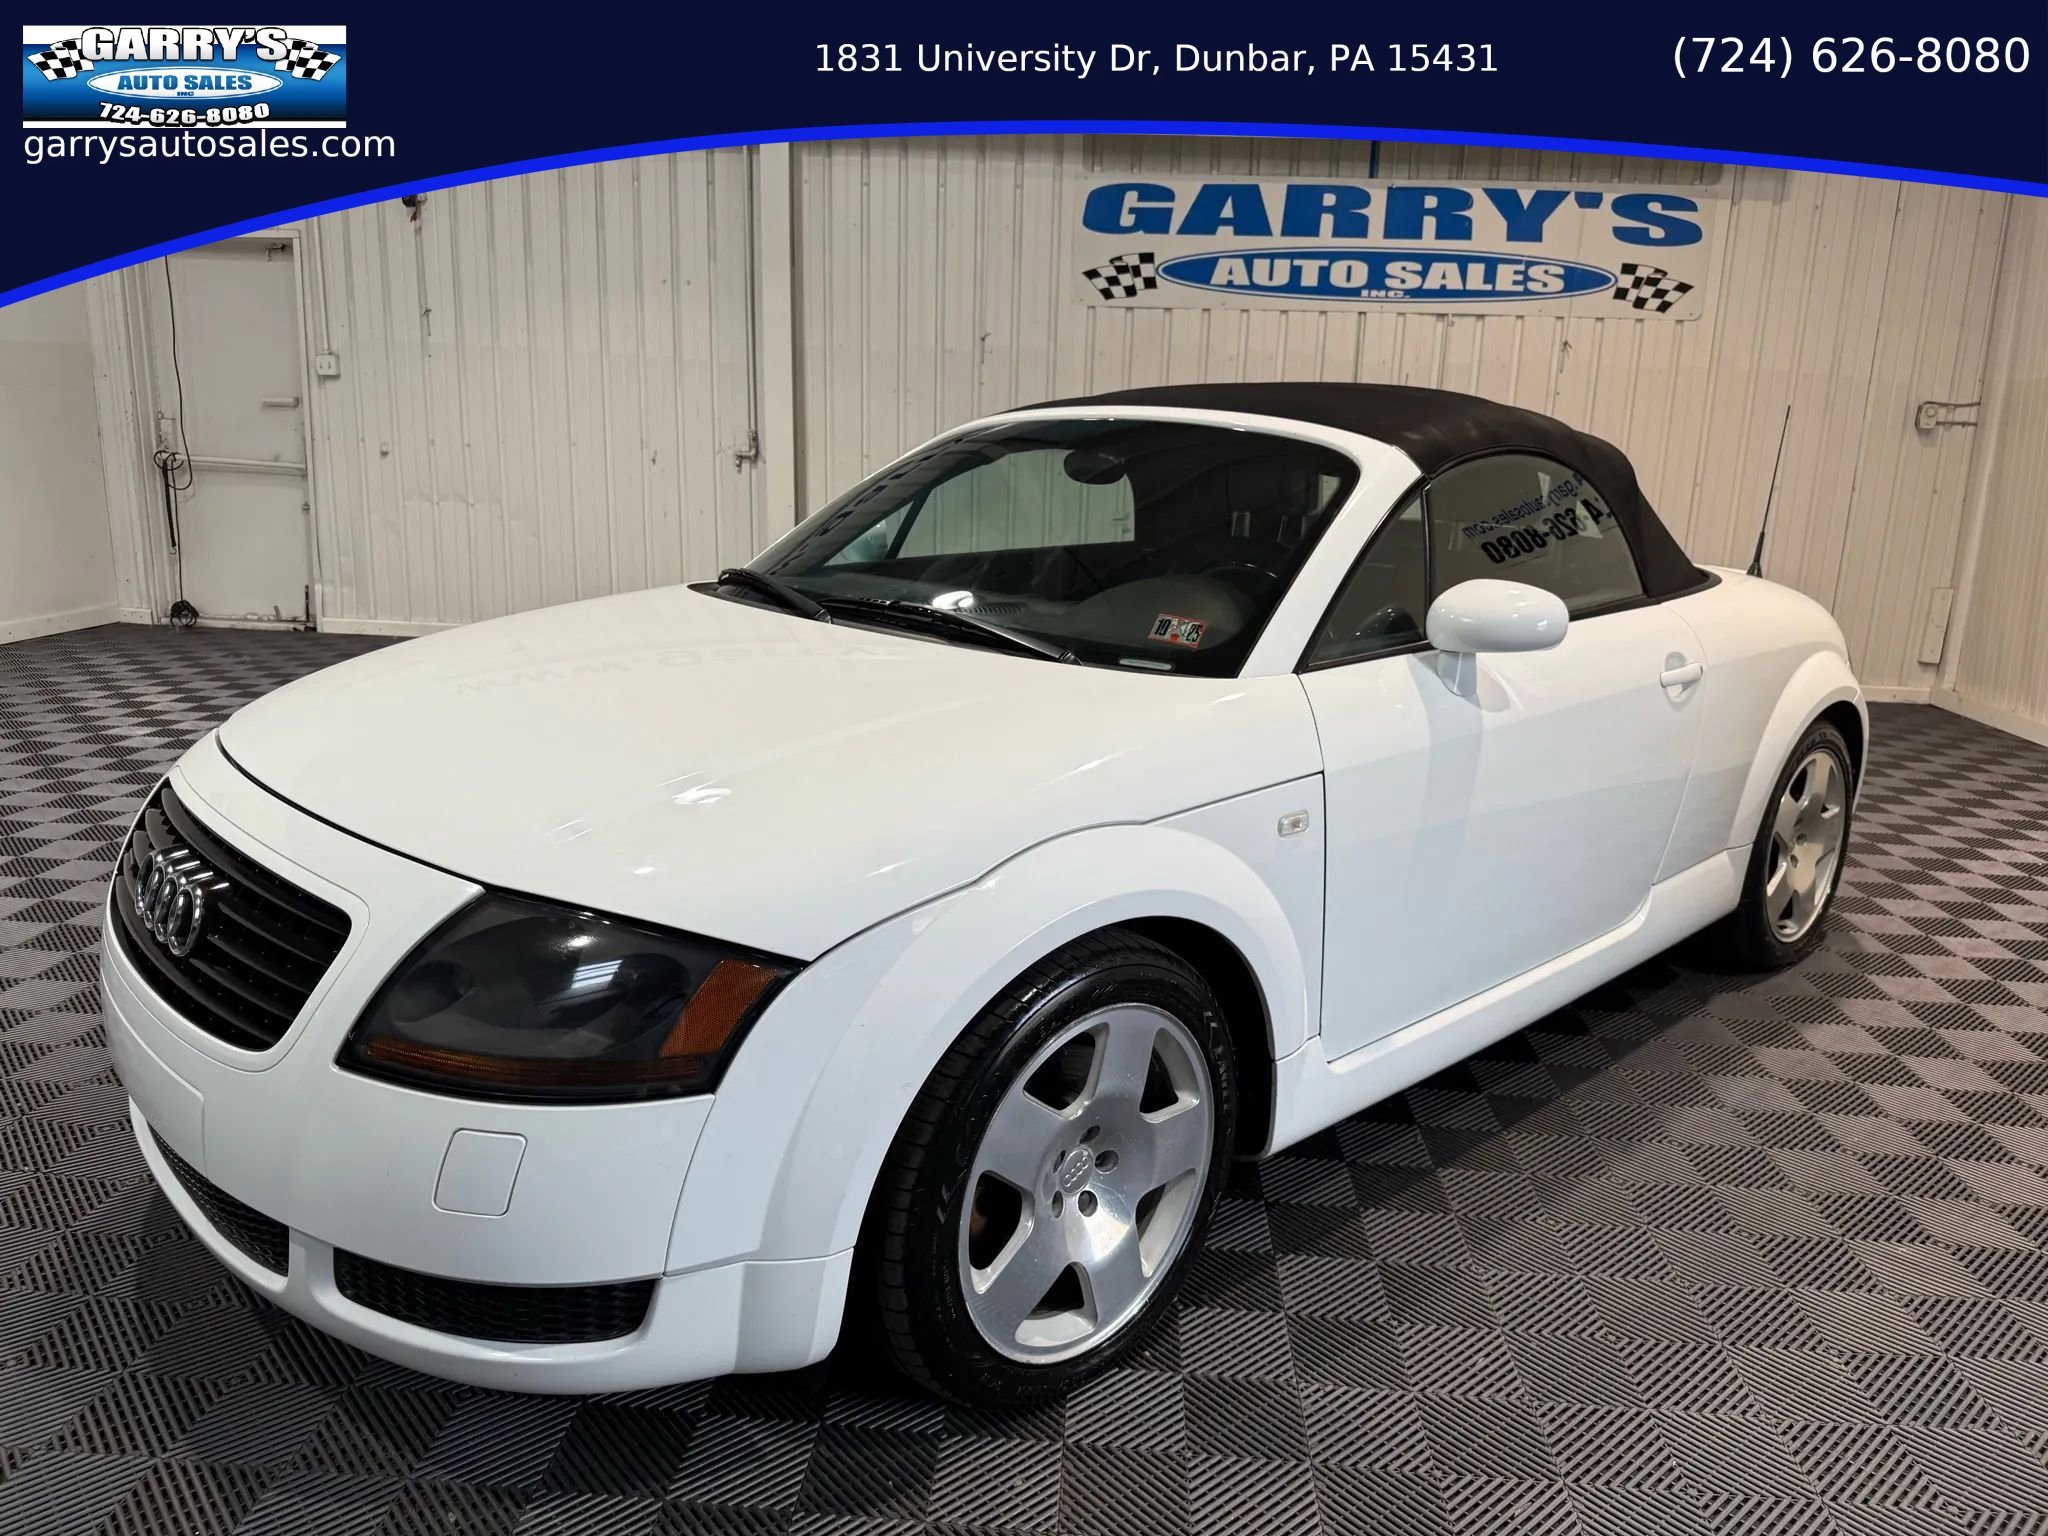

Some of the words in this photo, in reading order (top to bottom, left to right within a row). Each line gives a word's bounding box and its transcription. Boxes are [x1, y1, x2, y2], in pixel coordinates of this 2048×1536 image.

[1082, 183, 1703, 248] GARRY'S
[1209, 258, 1369, 288] AUTO
[1384, 260, 1566, 293] SALES
[1361, 289, 1410, 299] INC.
[1154, 618, 1172, 636] 10
[1186, 623, 1204, 642] 25
